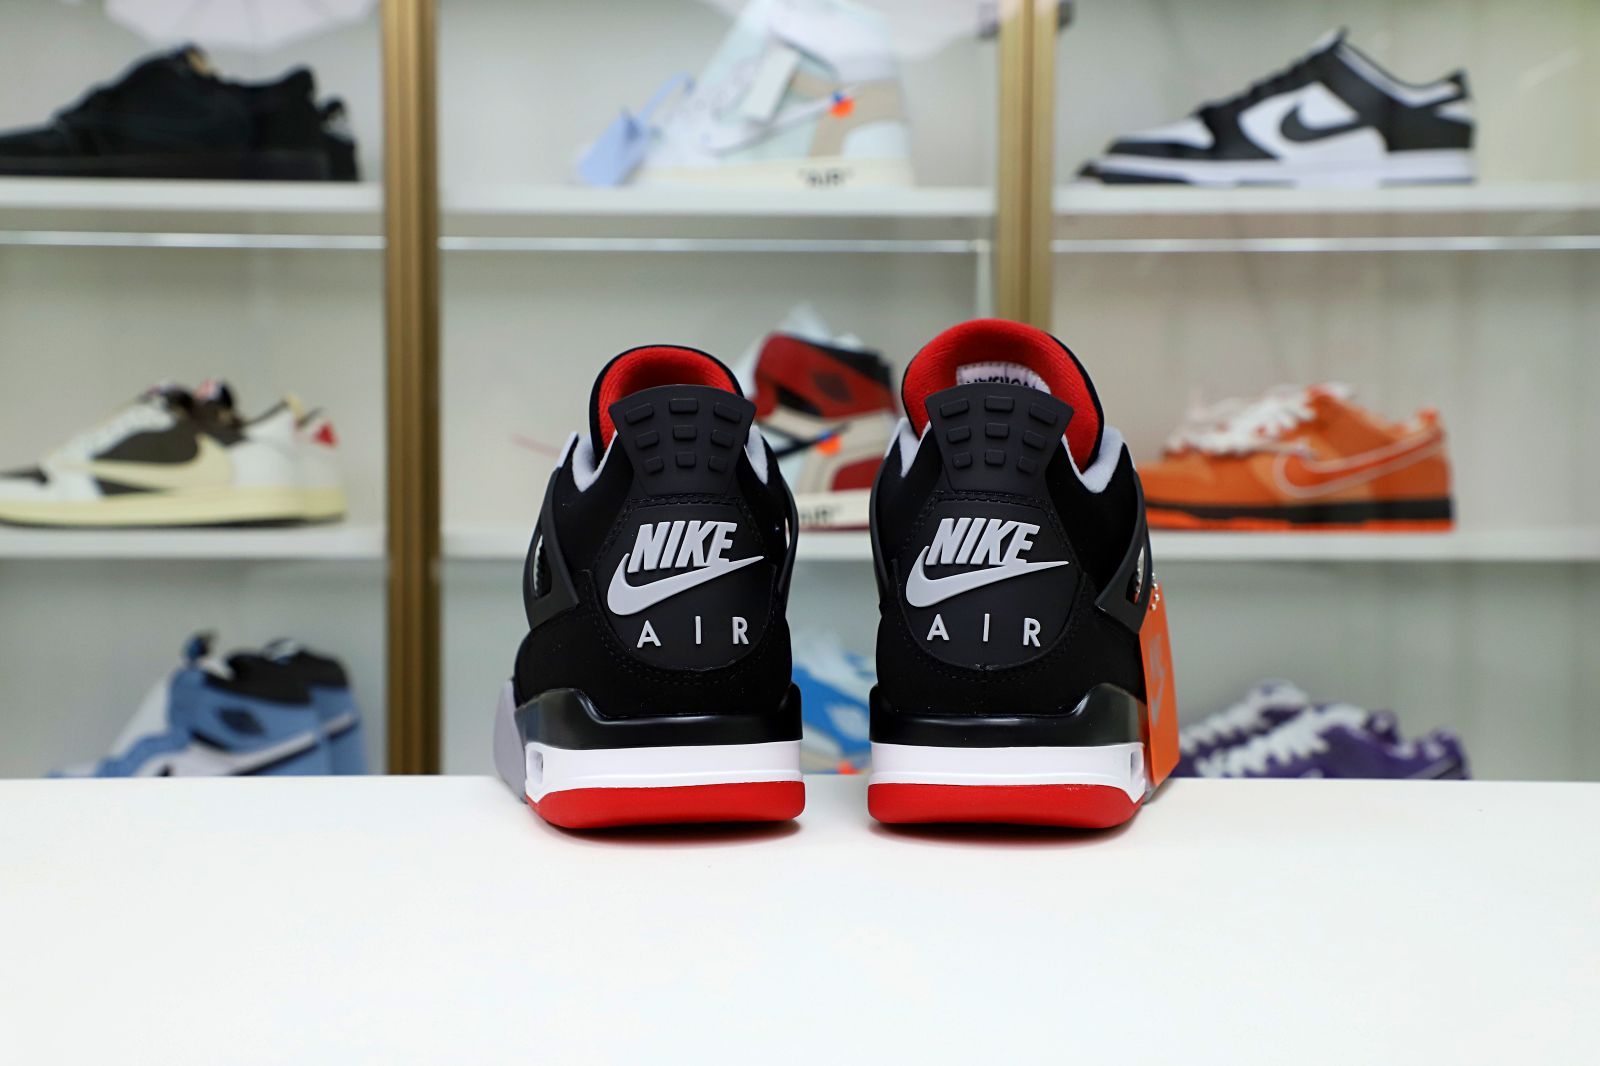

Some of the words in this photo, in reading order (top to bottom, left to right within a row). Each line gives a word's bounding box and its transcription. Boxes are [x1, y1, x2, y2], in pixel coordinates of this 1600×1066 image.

[627, 520, 738, 574] NIKE
[925, 517, 1041, 566] NIKE
[636, 615, 750, 649] AIR
[926, 613, 1042, 647] AIR
